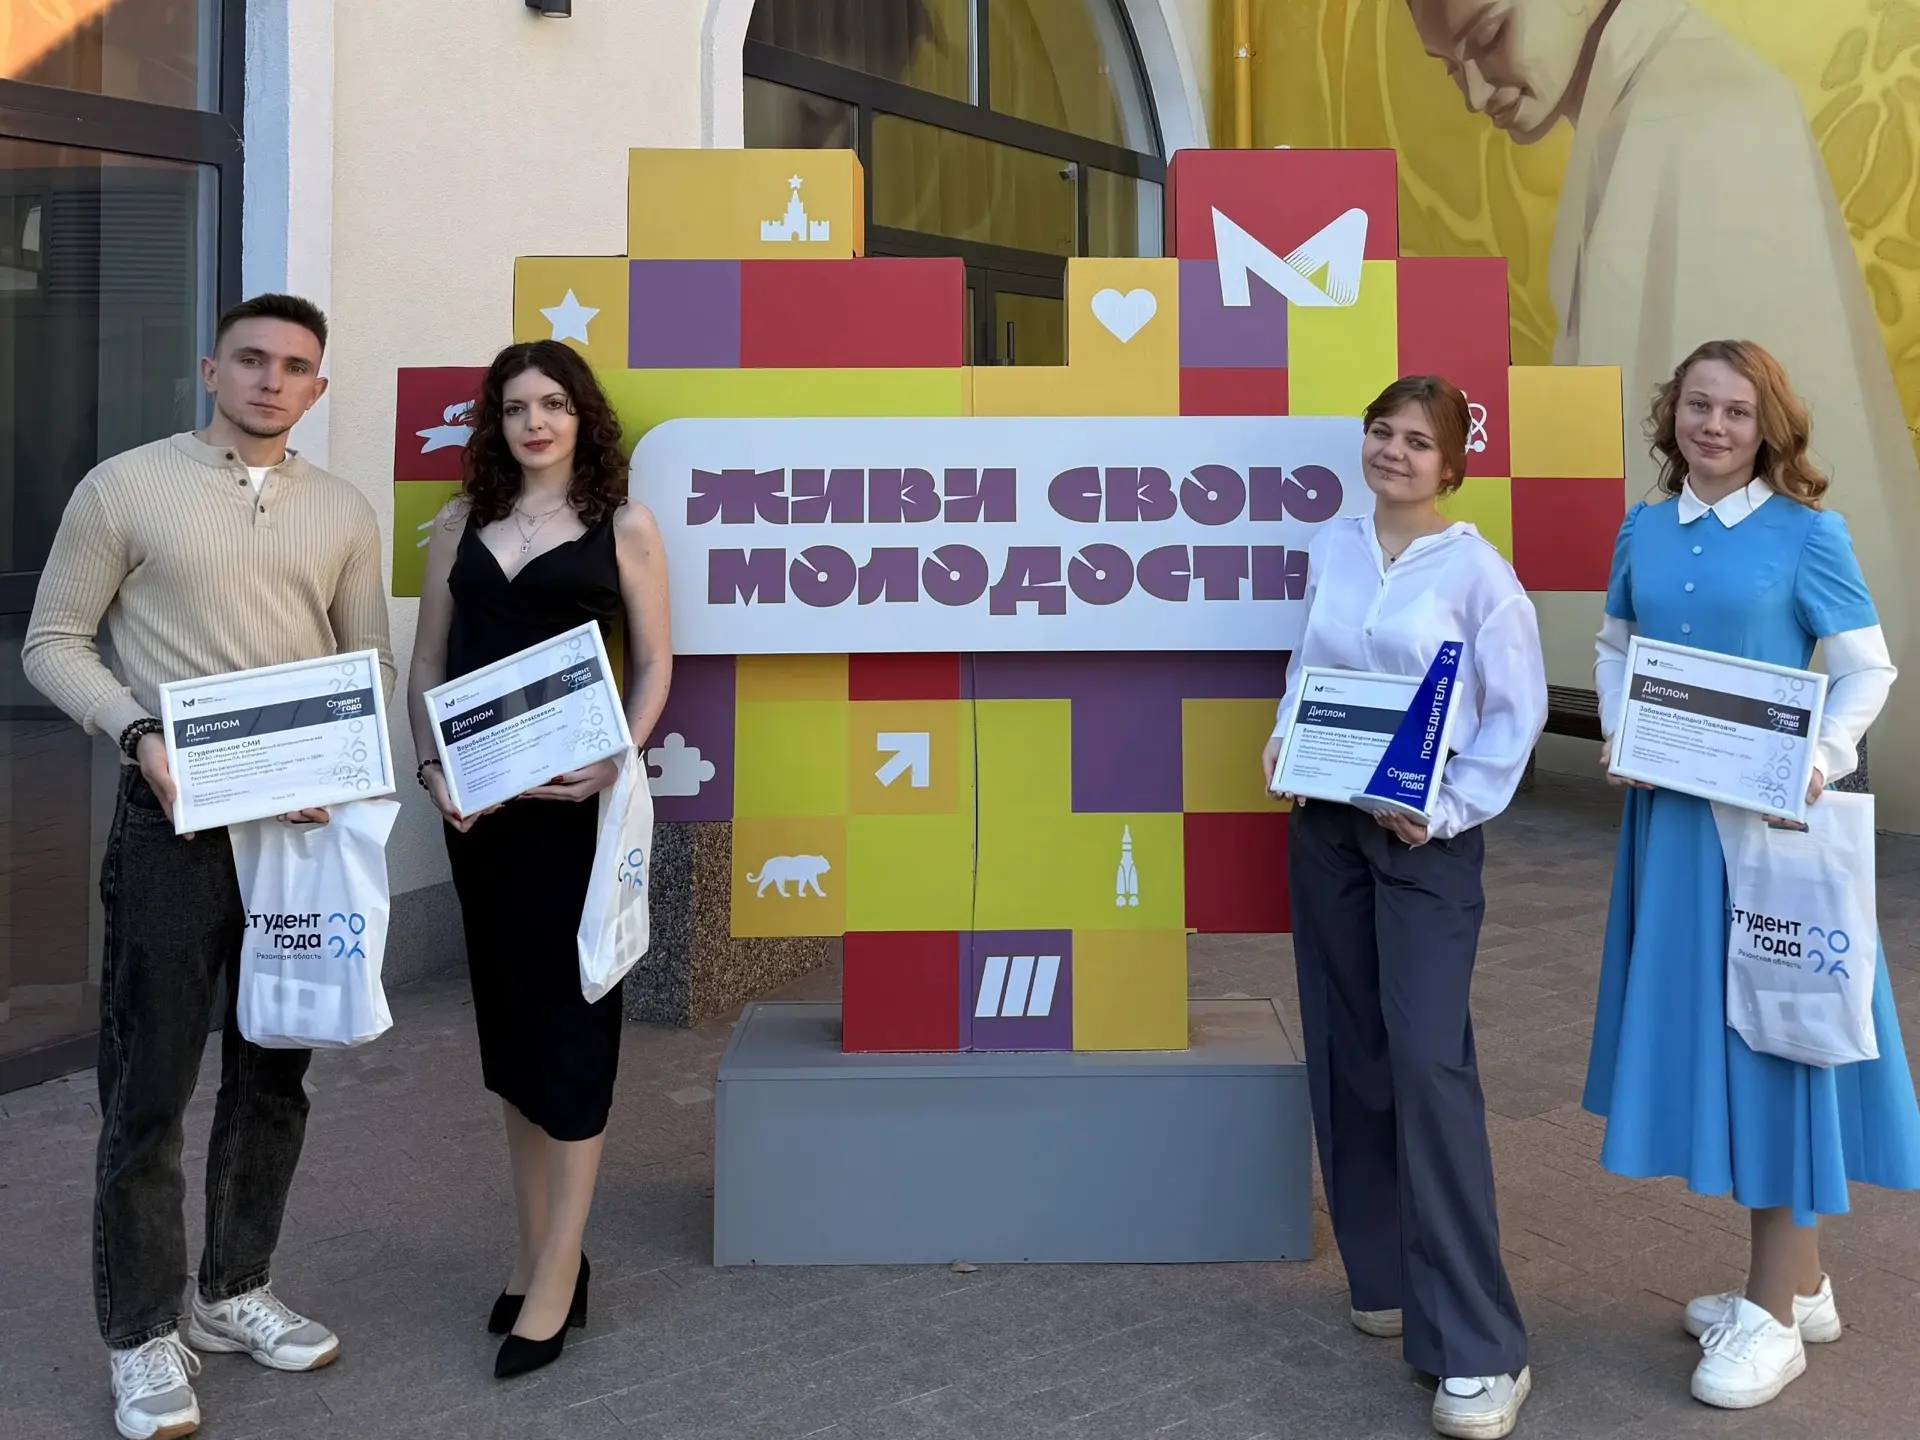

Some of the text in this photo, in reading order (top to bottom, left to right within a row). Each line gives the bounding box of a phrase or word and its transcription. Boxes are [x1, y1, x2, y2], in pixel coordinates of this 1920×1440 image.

[687, 464, 1343, 525] ЖИВИ СВОЮ
[708, 543, 1309, 615] МОЛОДОСТЬ
[561, 666, 590, 681] Студент
[575, 672, 592, 683] года
[1642, 681, 1689, 700] Диплом
[326, 697, 361, 708] Студент
[341, 703, 362, 712] года
[1307, 705, 1346, 719] Диплом
[1420, 676, 1448, 759] ПОБЕДИТЕЛЬ
[1767, 708, 1800, 721] Студент
[186, 719, 240, 738] Диплом
[452, 709, 494, 734] Диплом
[1780, 718, 1800, 728] года
[241, 739, 261, 749] СМИ
[1387, 767, 1427, 781] Студент
[1401, 780, 1425, 790] года
[274, 933, 321, 950] года
[1754, 934, 1801, 958] года
[293, 952, 322, 960] область
